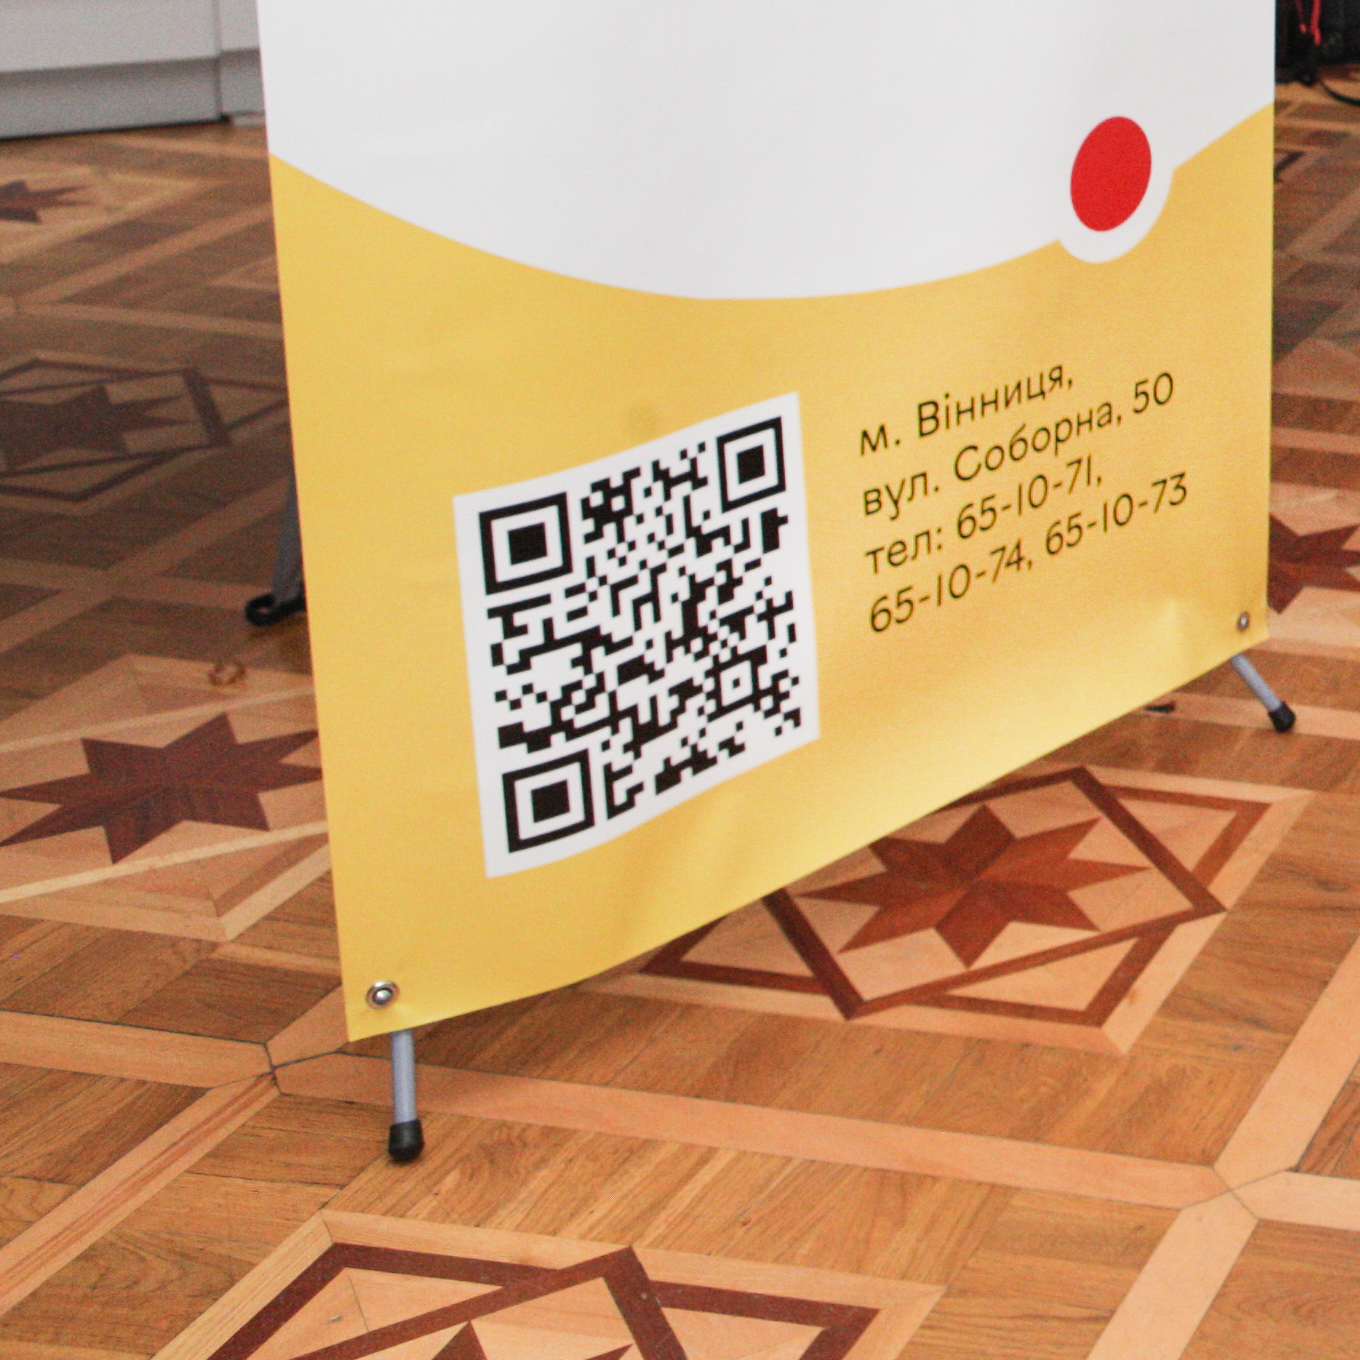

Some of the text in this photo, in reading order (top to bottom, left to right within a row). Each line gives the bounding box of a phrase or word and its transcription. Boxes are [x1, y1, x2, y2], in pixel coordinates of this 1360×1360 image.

[859, 364, 1074, 457] м. Вінниця,
[862, 372, 1175, 521] вул. Соборна, 50
[863, 454, 1102, 575] тел: 65-10-71,
[868, 471, 1188, 634] 65-10-74, 65-10-73
